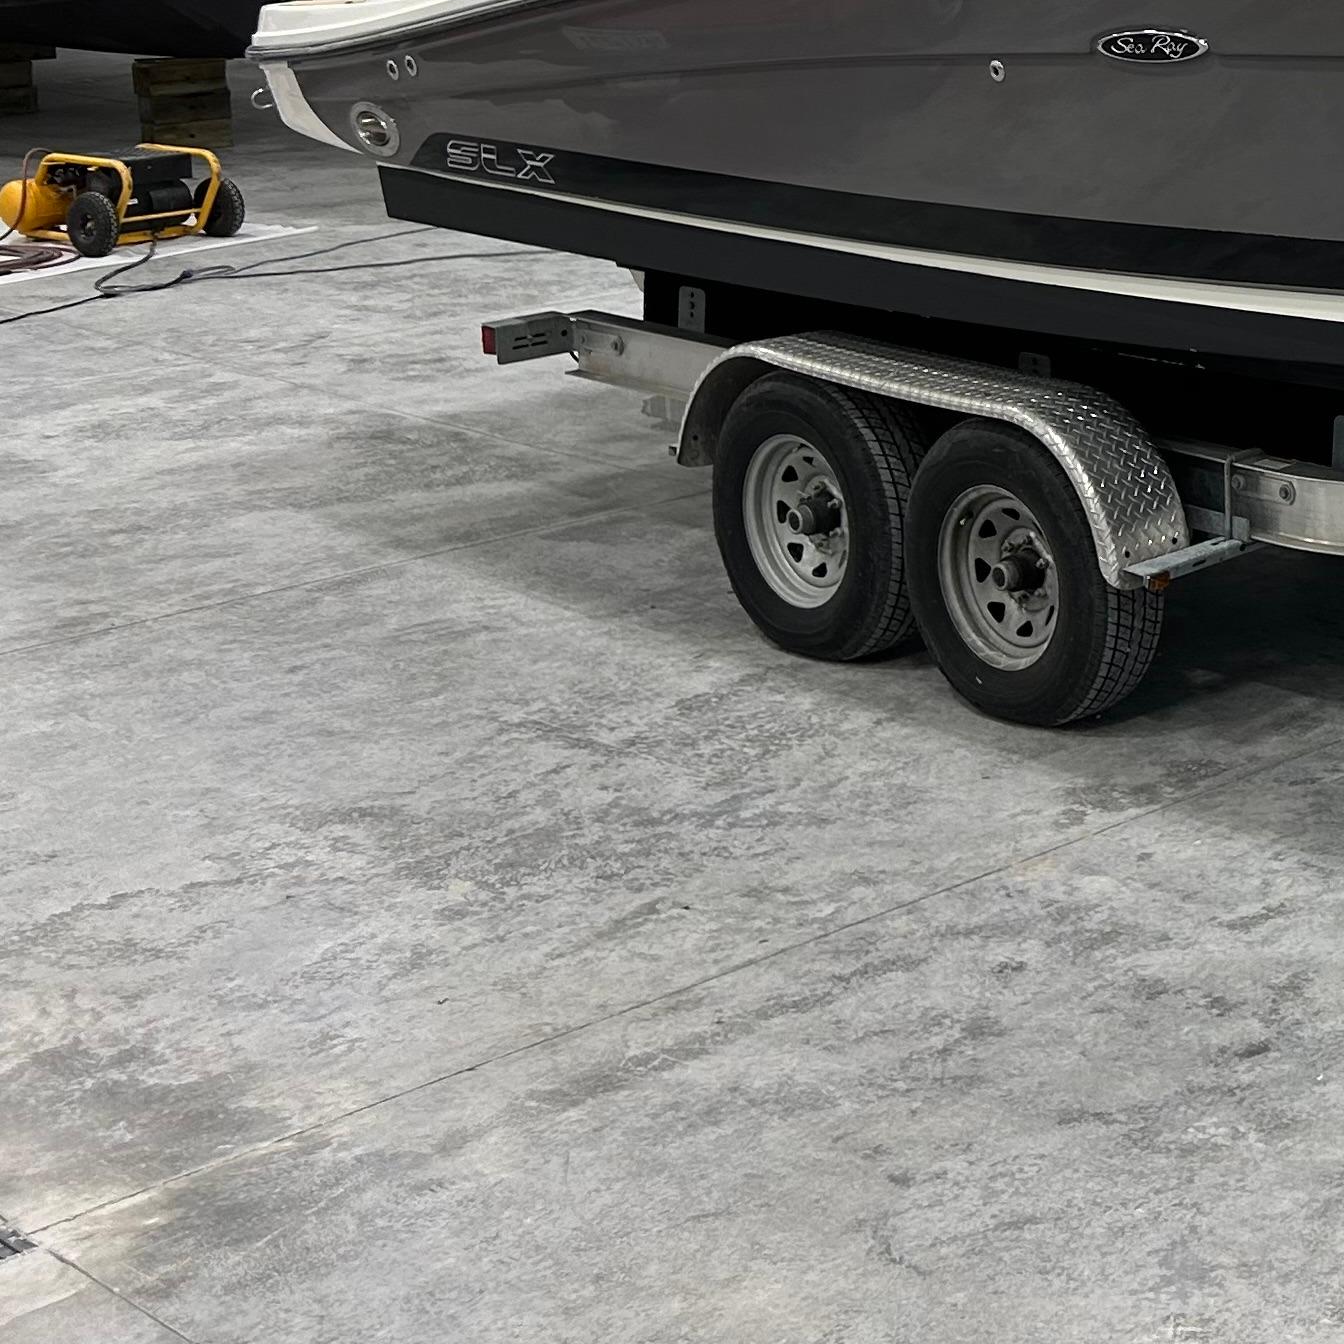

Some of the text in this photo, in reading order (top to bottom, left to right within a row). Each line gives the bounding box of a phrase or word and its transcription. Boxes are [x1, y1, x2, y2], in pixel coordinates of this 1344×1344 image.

[1111, 34, 1188, 58] Sea Ray
[447, 140, 555, 184] SLX
